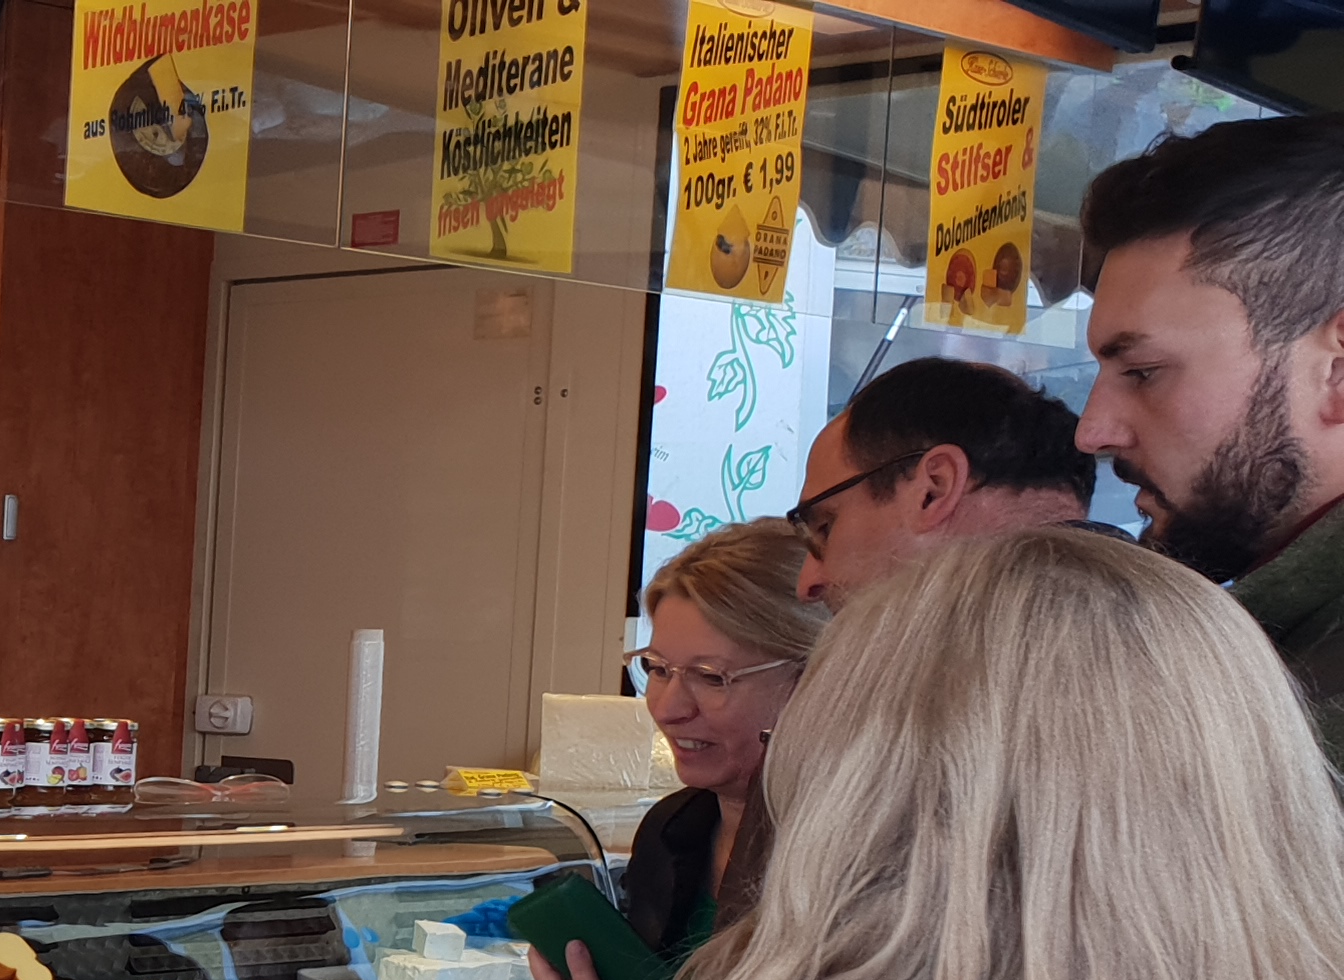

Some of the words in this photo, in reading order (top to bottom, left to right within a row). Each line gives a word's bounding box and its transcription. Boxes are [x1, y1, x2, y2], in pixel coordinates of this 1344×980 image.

[690, 20, 794, 68] Italienischer
[443, 45, 574, 112] Mediterane
[683, 81, 737, 129] Grana
[740, 63, 804, 115] Padano
[84, 118, 106, 140] aus
[211, 86, 246, 114] F.i.Tr.
[942, 88, 1030, 135] Südtiroler
[440, 105, 572, 181] Köstlichkeiten
[693, 132, 718, 164] Jahre
[936, 142, 1013, 196] Stilfser
[1022, 127, 1034, 171] &
[685, 174, 737, 210] 100gr.
[743, 161, 754, 193] €
[760, 151, 795, 193] 1,99
[935, 184, 1027, 258] Dolomitenkönig
